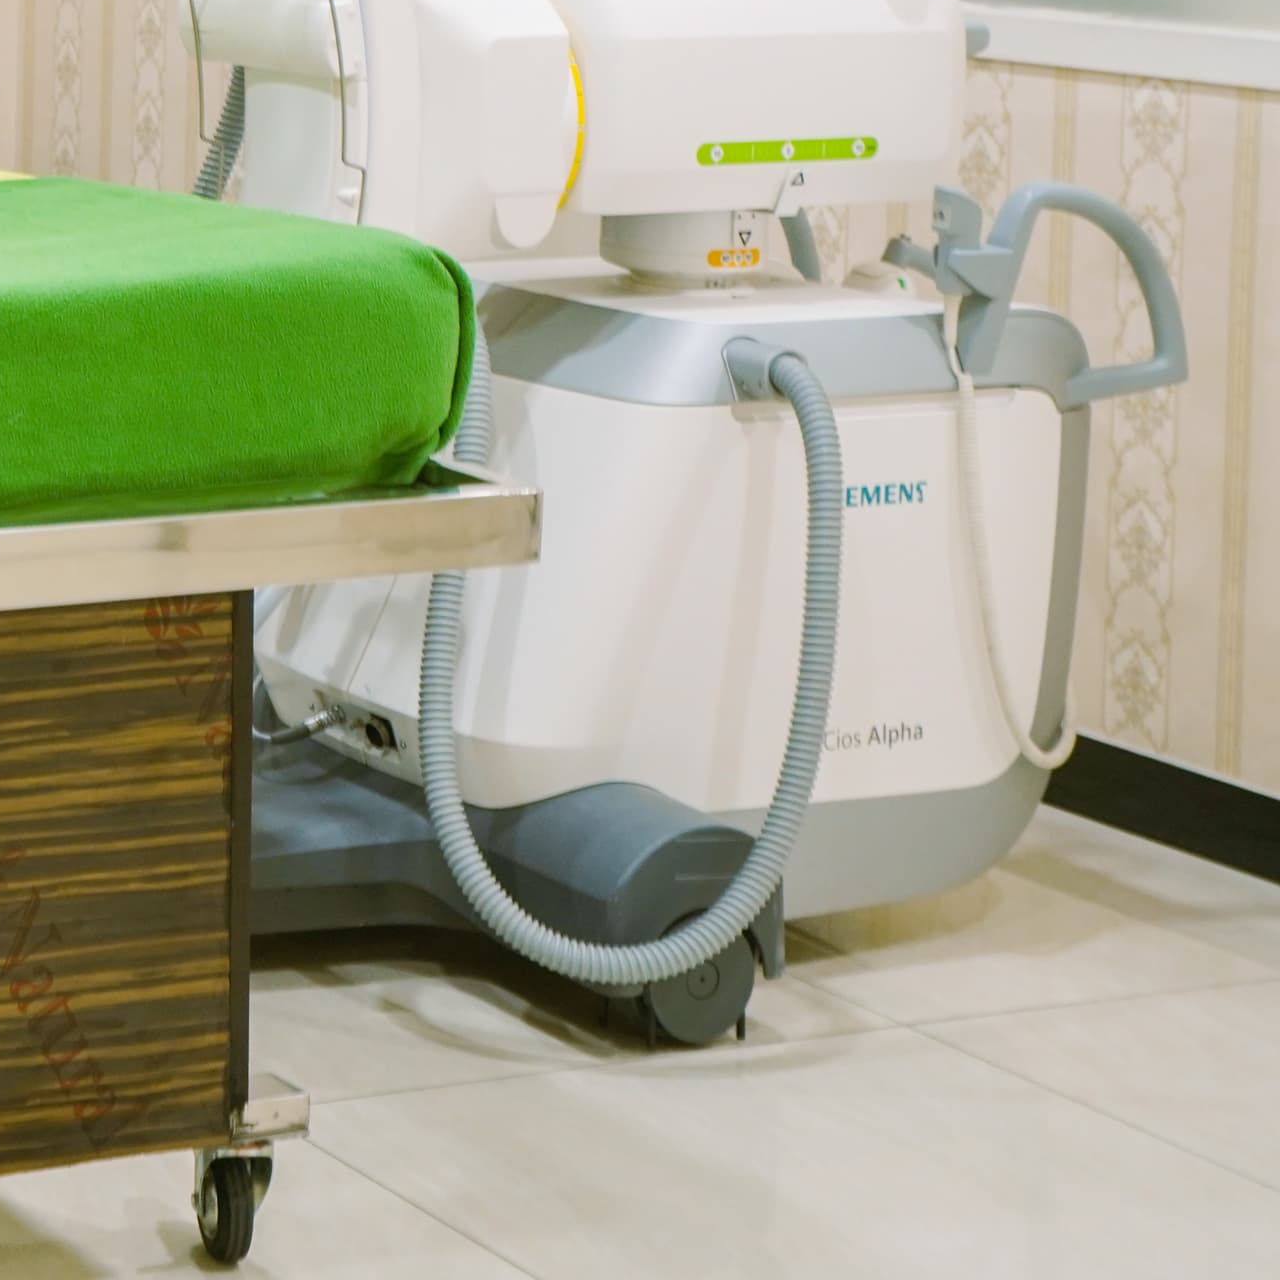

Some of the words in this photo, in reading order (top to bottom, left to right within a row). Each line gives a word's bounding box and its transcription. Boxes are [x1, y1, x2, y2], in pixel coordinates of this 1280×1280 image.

[845, 481, 928, 508] EMENS
[824, 728, 861, 752] Cios
[867, 722, 923, 749] Alpha
